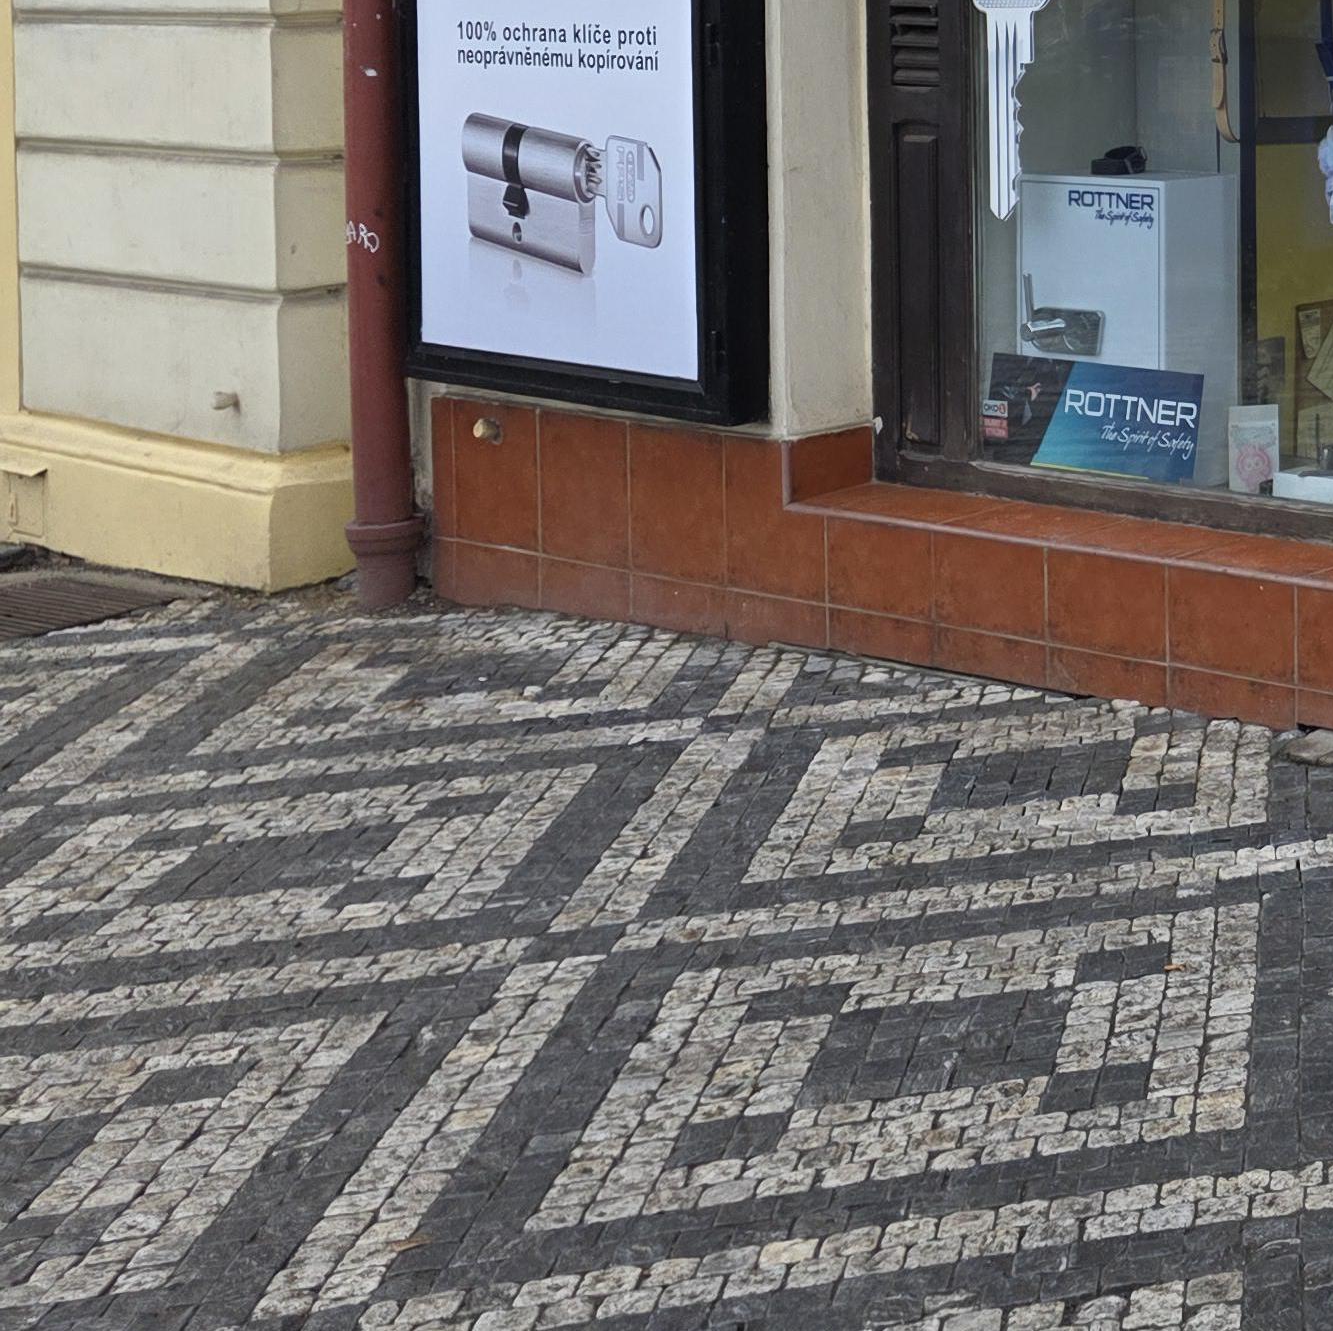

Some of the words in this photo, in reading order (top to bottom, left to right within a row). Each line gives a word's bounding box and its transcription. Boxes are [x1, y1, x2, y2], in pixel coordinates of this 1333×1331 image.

[457, 21, 496, 41] 100%
[502, 22, 567, 43] ochrana
[572, 23, 612, 45] klíče
[617, 25, 657, 52] proti
[457, 46, 573, 69] neoprávněnému
[578, 49, 659, 73] kopírování
[1068, 190, 1154, 211] ROTTNER
[1064, 389, 1198, 428] ROTTNER
[1101, 422, 1117, 441] The
[1117, 427, 1148, 451] Spirit
[1158, 432, 1194, 460] Safety
